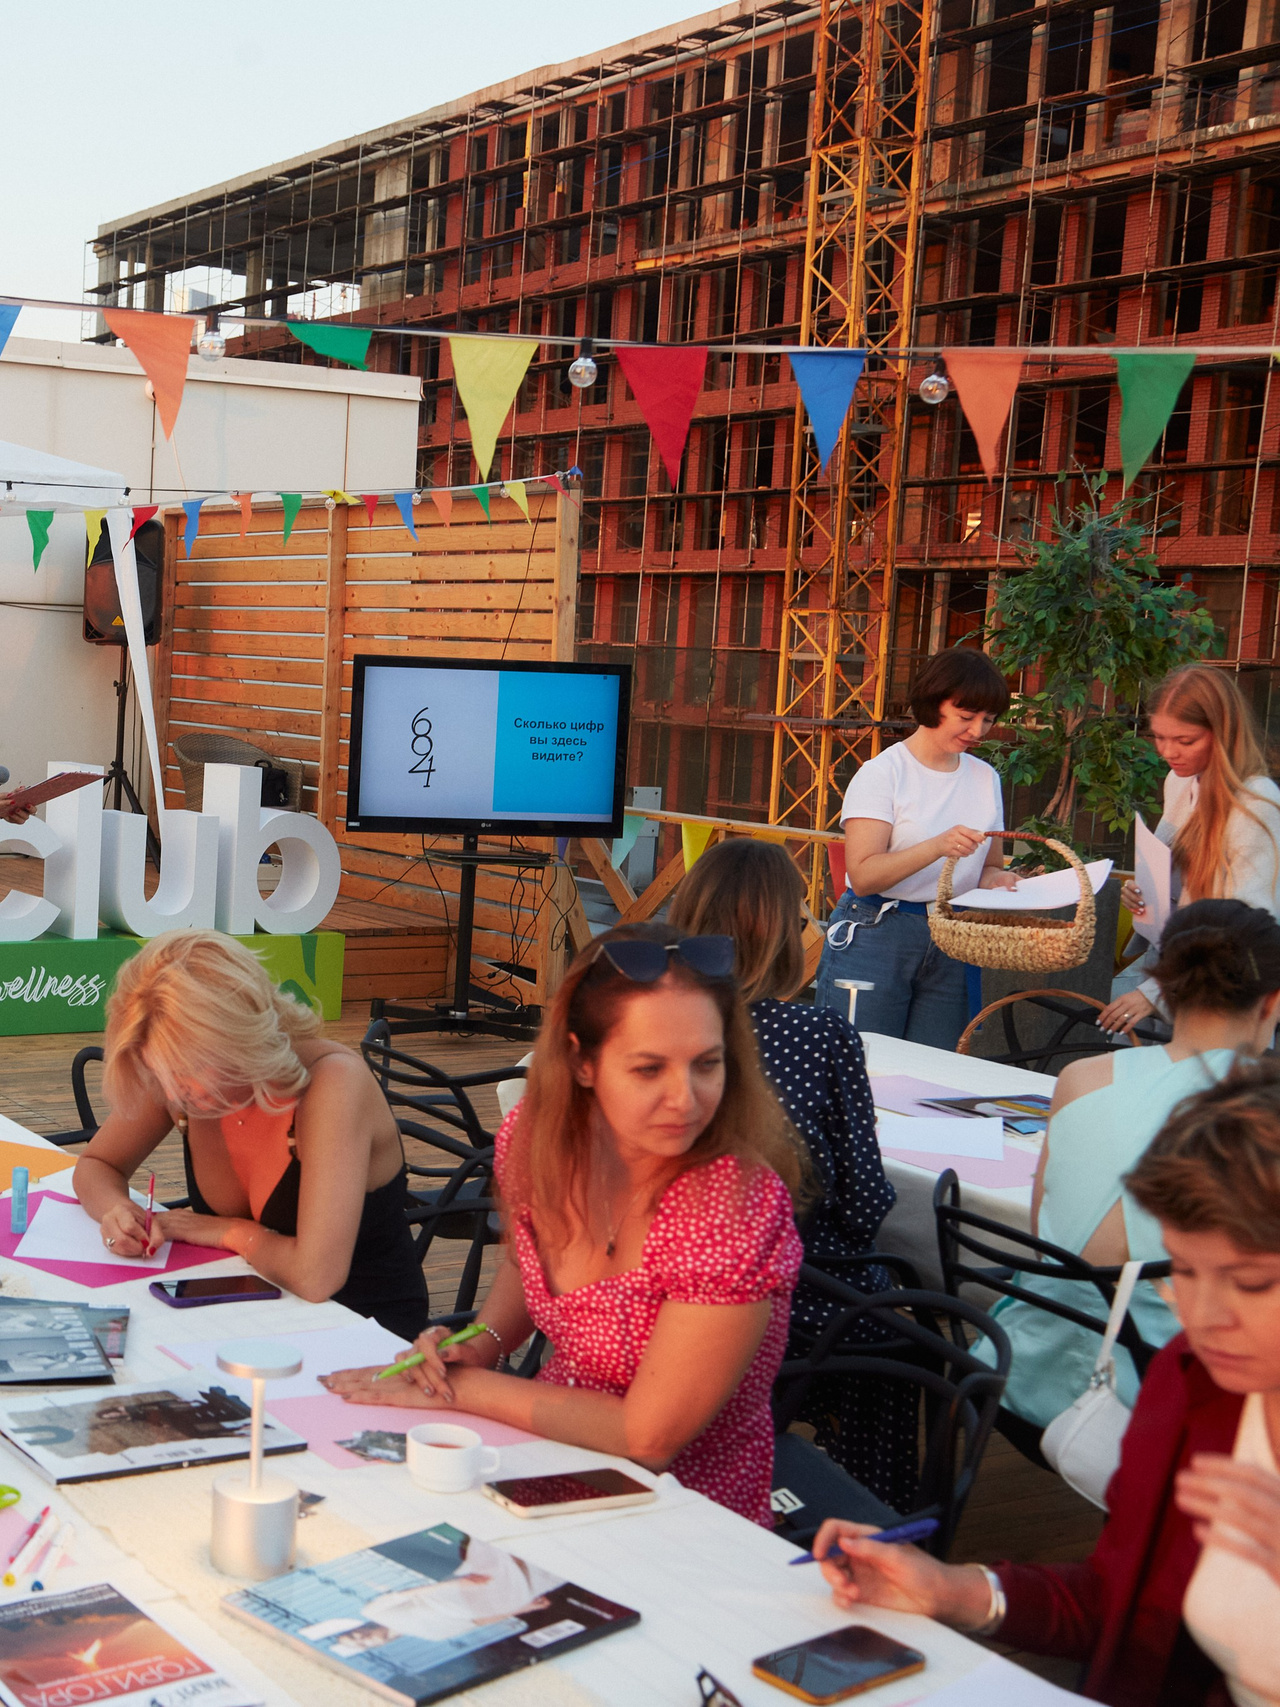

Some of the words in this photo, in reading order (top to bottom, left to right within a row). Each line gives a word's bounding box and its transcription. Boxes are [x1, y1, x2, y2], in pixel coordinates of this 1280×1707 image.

[514, 716, 567, 730] Сколько
[570, 719, 605, 733] цифр
[529, 735, 548, 745] вы
[551, 735, 588, 747] здесь
[531, 750, 584, 763] видите?
[21, 1680, 111, 1707] ГОРА
